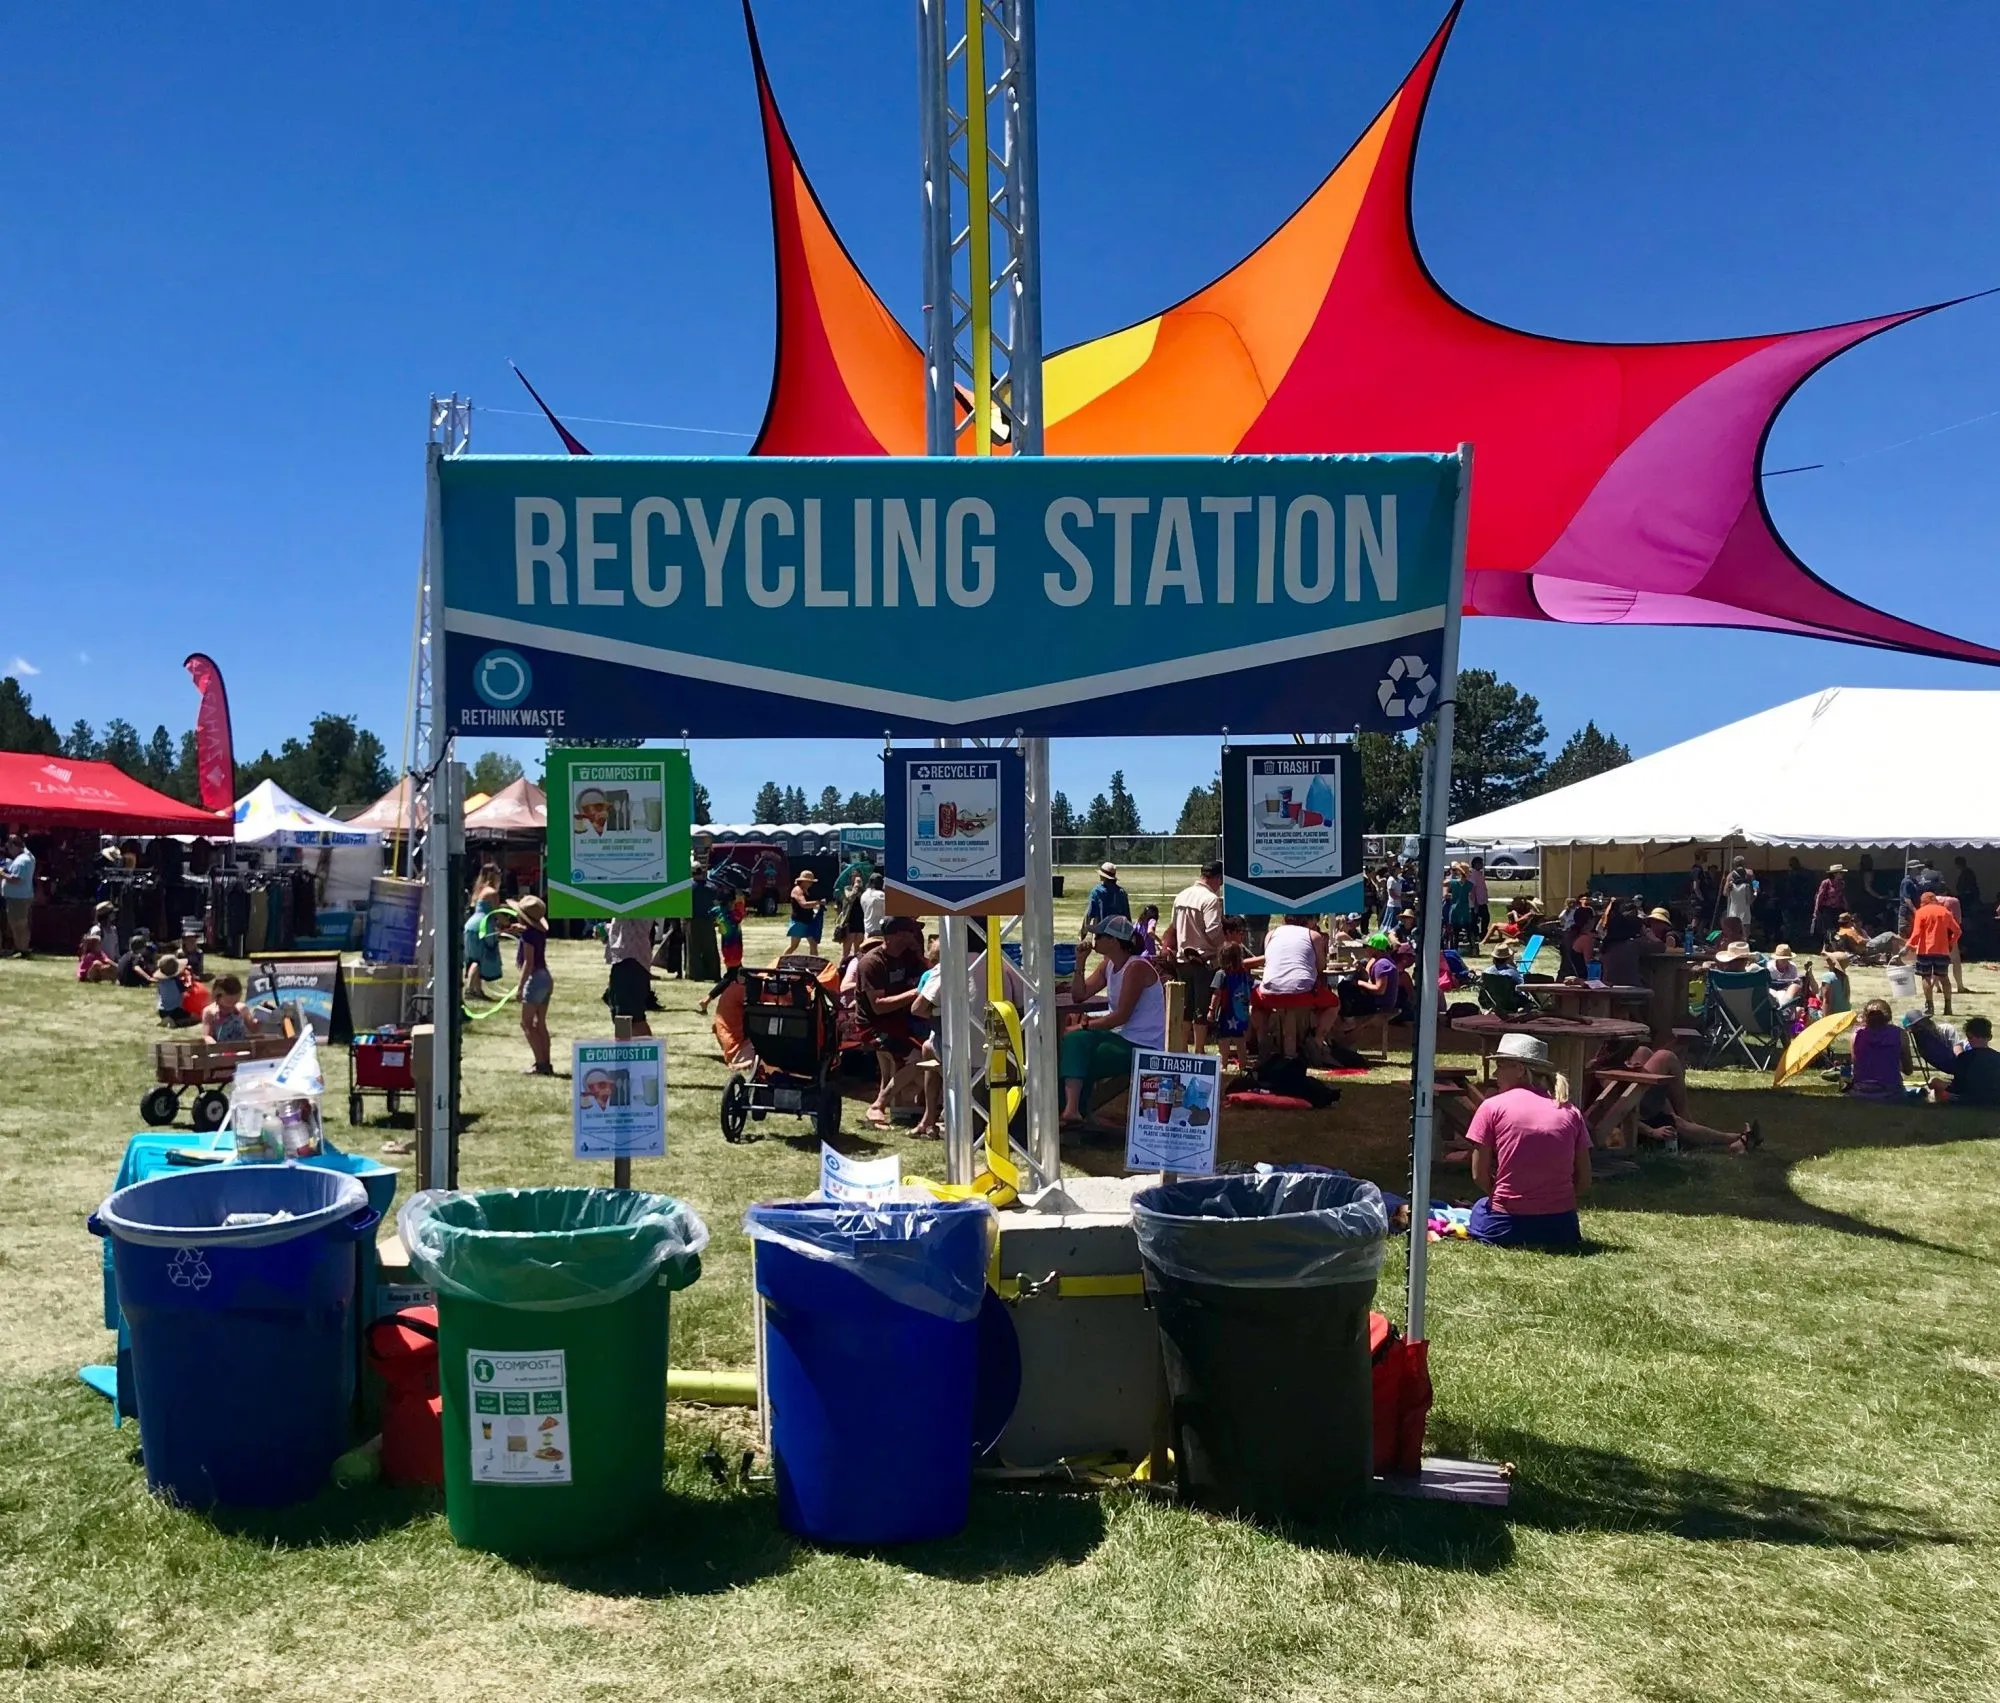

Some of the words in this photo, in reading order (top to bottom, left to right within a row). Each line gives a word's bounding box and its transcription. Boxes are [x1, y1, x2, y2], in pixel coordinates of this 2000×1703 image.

[514, 496, 996, 608] RECYCLING
[1043, 494, 1398, 606] STATION
[461, 709, 566, 726] RETHINKWASTE
[591, 767, 640, 780] COMPOST
[643, 767, 653, 780] IT
[931, 765, 976, 778] RECYCLE
[979, 765, 989, 778] IT
[1277, 761, 1309, 774] TRASH
[1311, 761, 1321, 773] IT
[596, 1048, 640, 1061] COMPOST
[642, 1047, 652, 1060] IT
[1162, 1057, 1192, 1073] TRASH
[1193, 1060, 1204, 1073] IT
[495, 1360, 552, 1371] COMPOST
